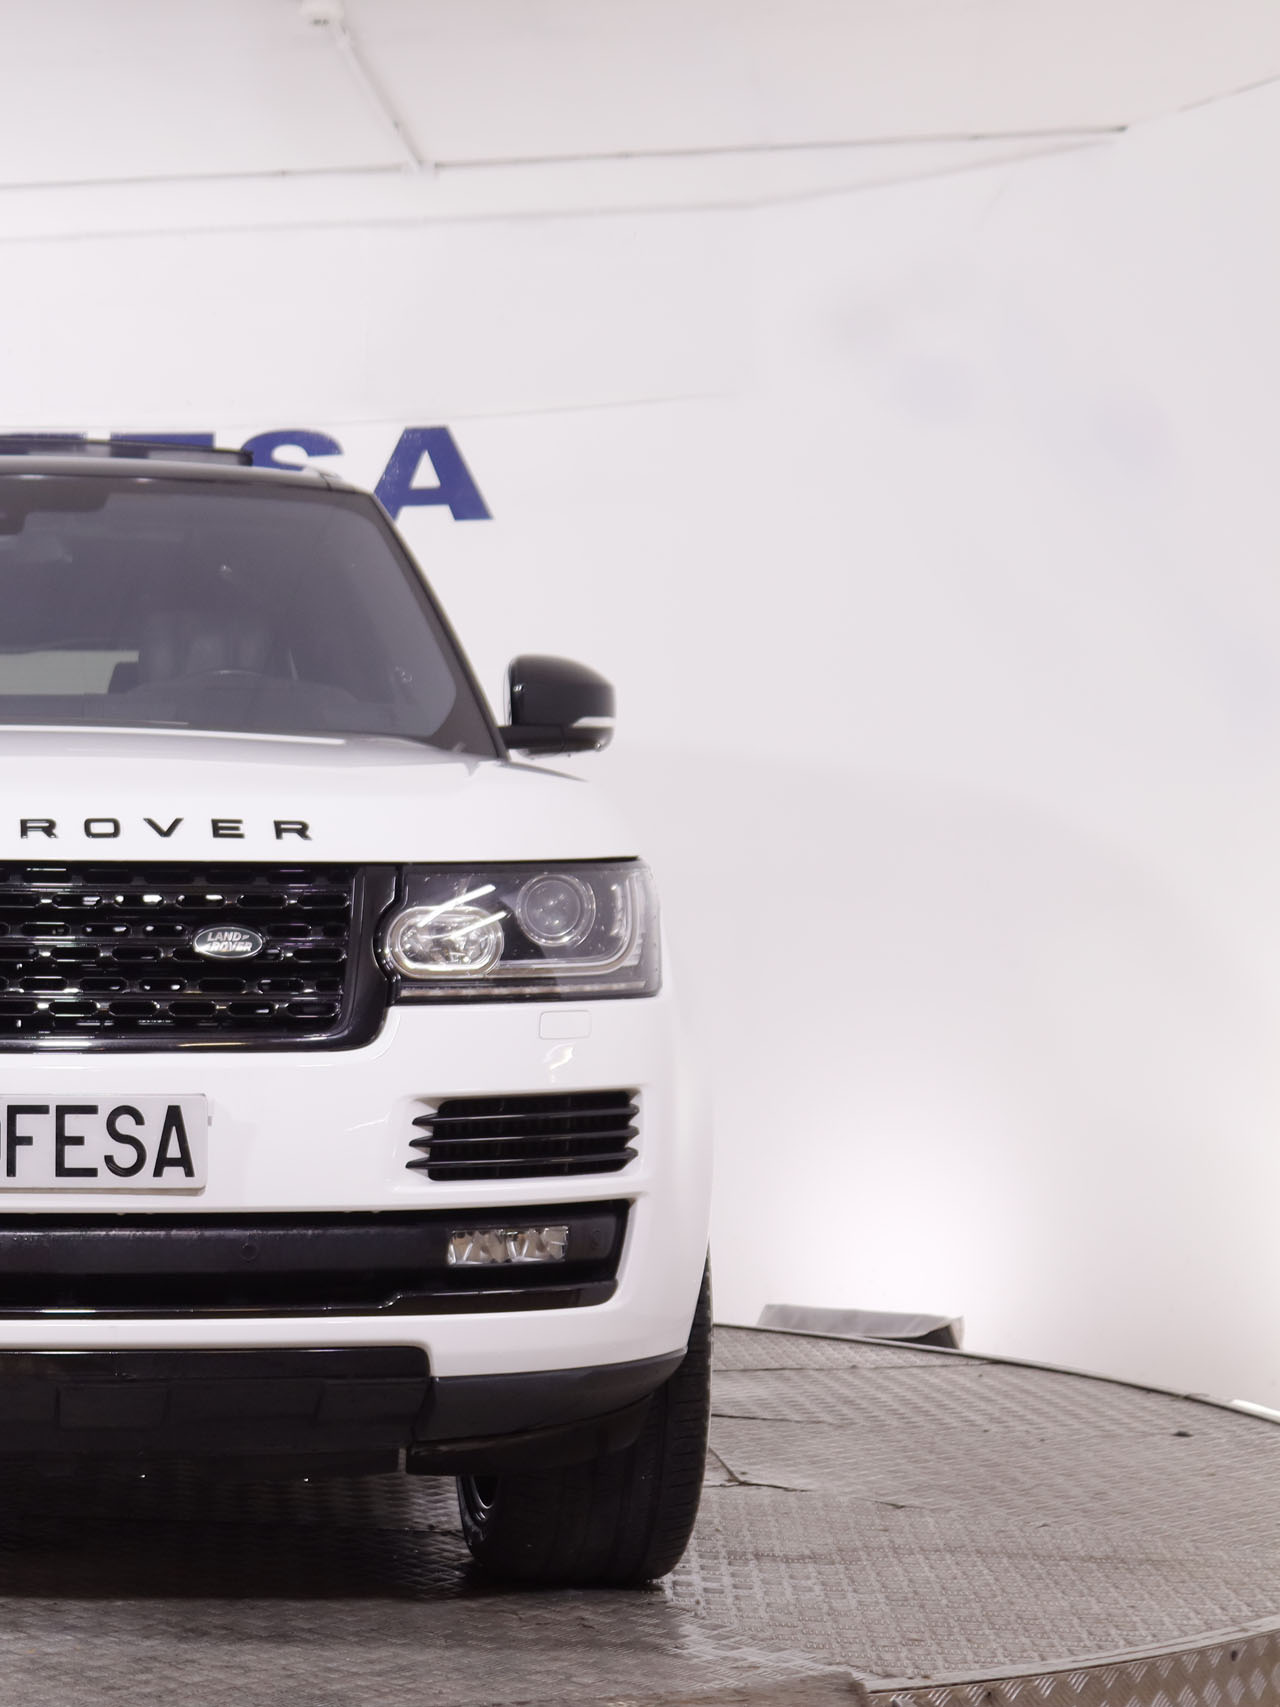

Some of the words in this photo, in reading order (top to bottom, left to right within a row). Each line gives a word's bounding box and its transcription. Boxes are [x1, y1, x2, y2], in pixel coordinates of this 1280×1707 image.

[19, 817, 312, 840] ROVER
[207, 931, 241, 942] LAND
[210, 941, 253, 952] ROVER
